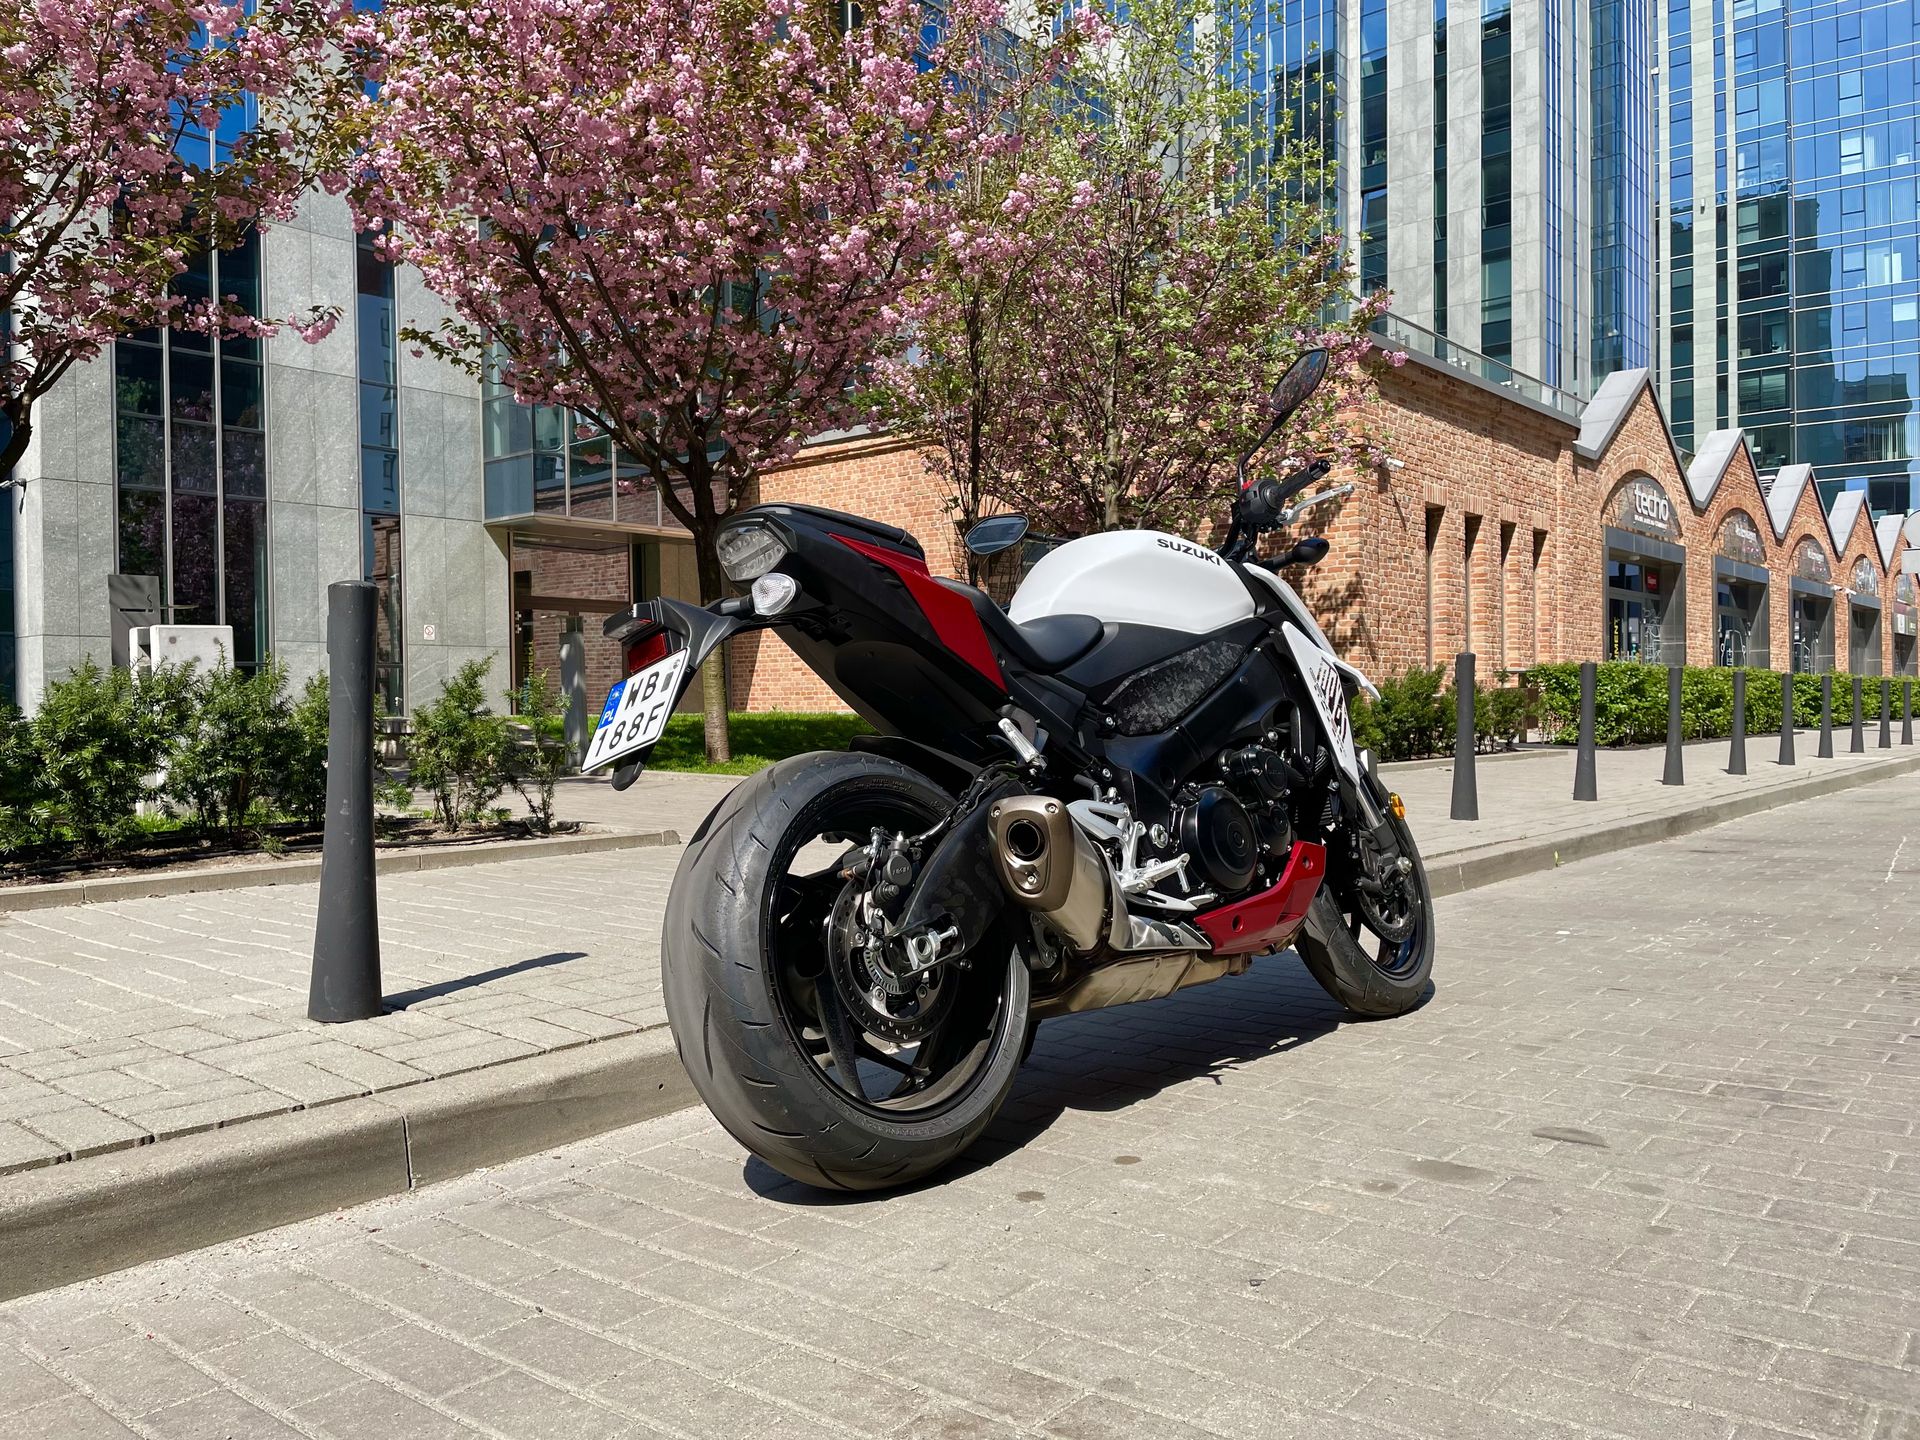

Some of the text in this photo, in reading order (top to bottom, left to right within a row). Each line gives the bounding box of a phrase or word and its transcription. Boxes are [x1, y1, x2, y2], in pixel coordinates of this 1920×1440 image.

[1157, 538, 1221, 566] SUZUKI
[624, 671, 660, 711] WB
[595, 701, 665, 757] 188F
[602, 708, 615, 725] PL
